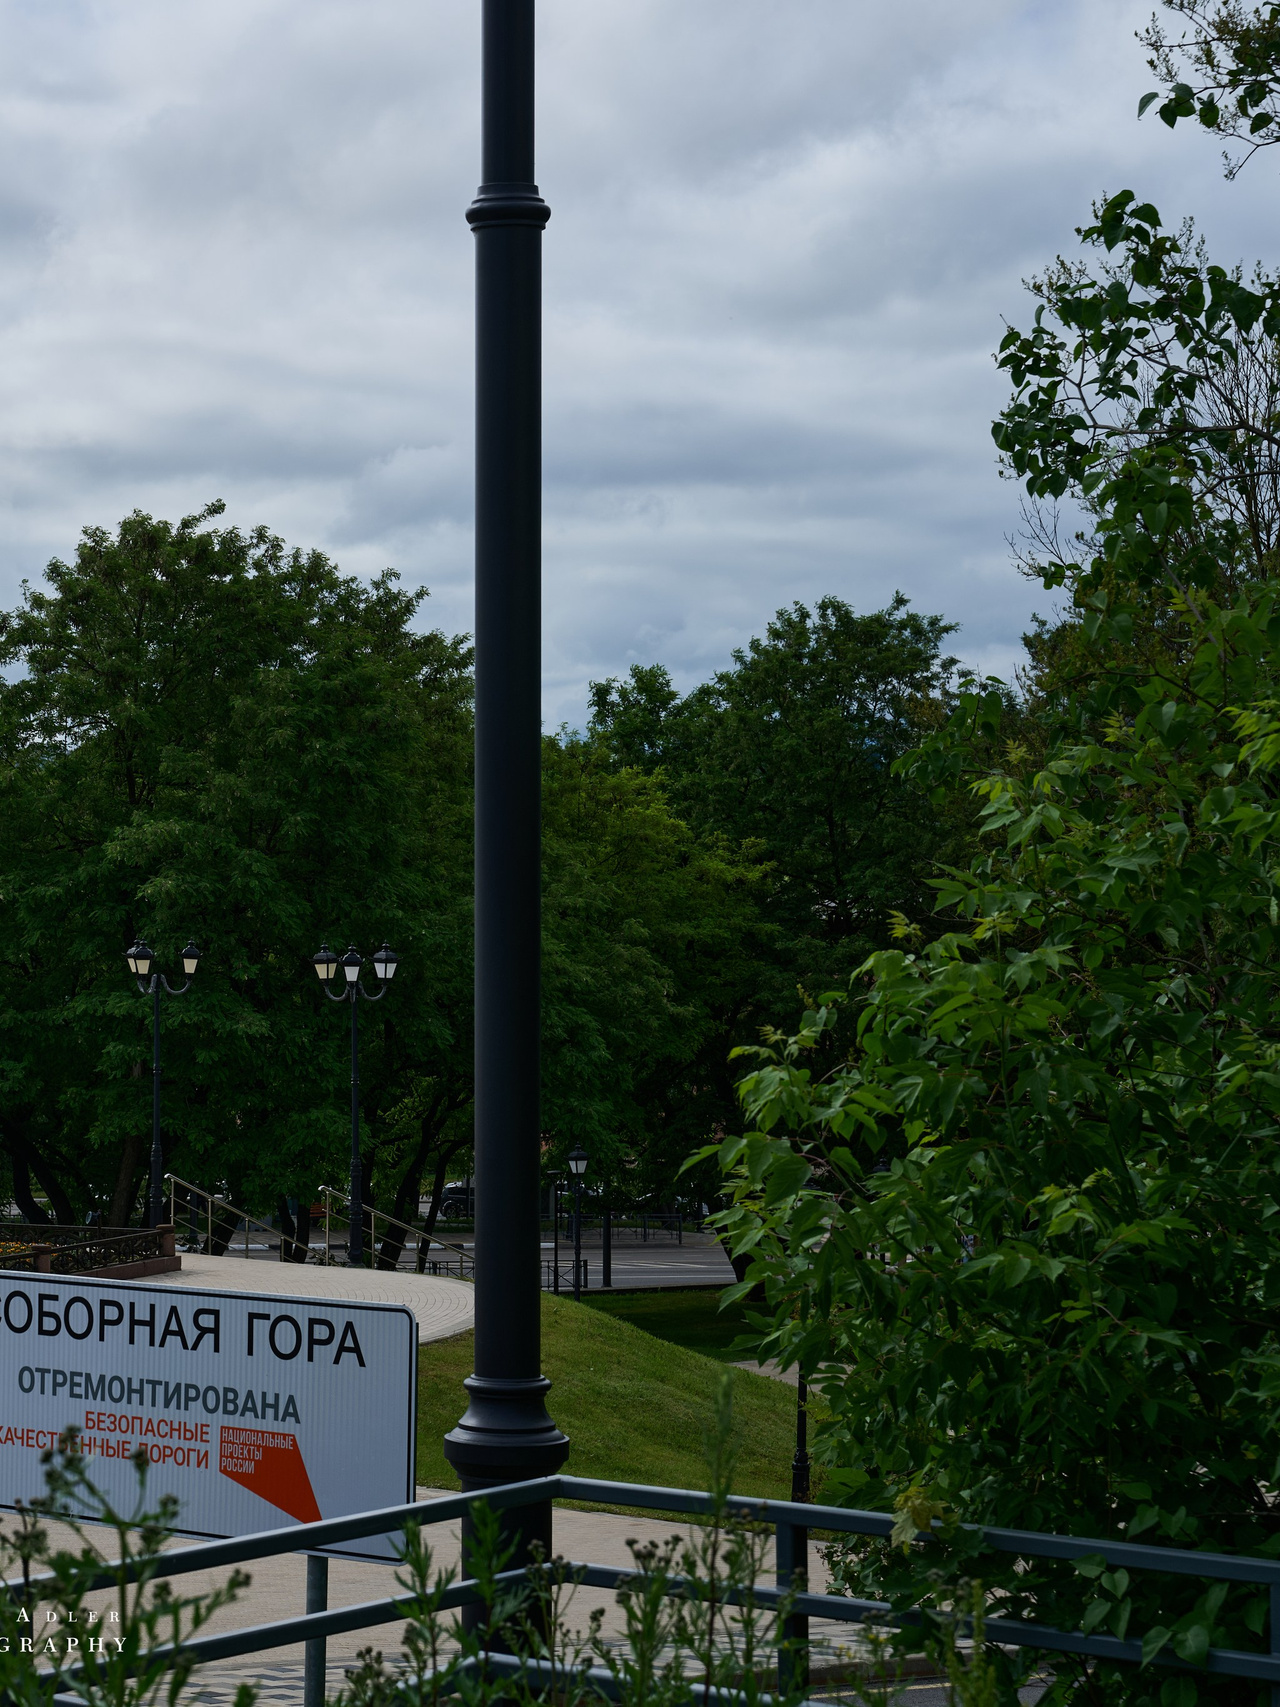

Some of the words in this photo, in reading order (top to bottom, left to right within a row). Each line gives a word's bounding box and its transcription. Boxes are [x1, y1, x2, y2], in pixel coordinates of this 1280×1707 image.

[247, 1311, 367, 1368] ГОРА
[18, 1365, 301, 1425] ОТРЕМОНТИРОВАНА
[84, 1410, 211, 1444] БЕЗОПАСНЫЕ
[221, 1427, 295, 1450] НАЦИОНАЛЬНЫЕ
[221, 1443, 263, 1461] ПРОЕКТЫ
[221, 1457, 256, 1475] РОССИИ
